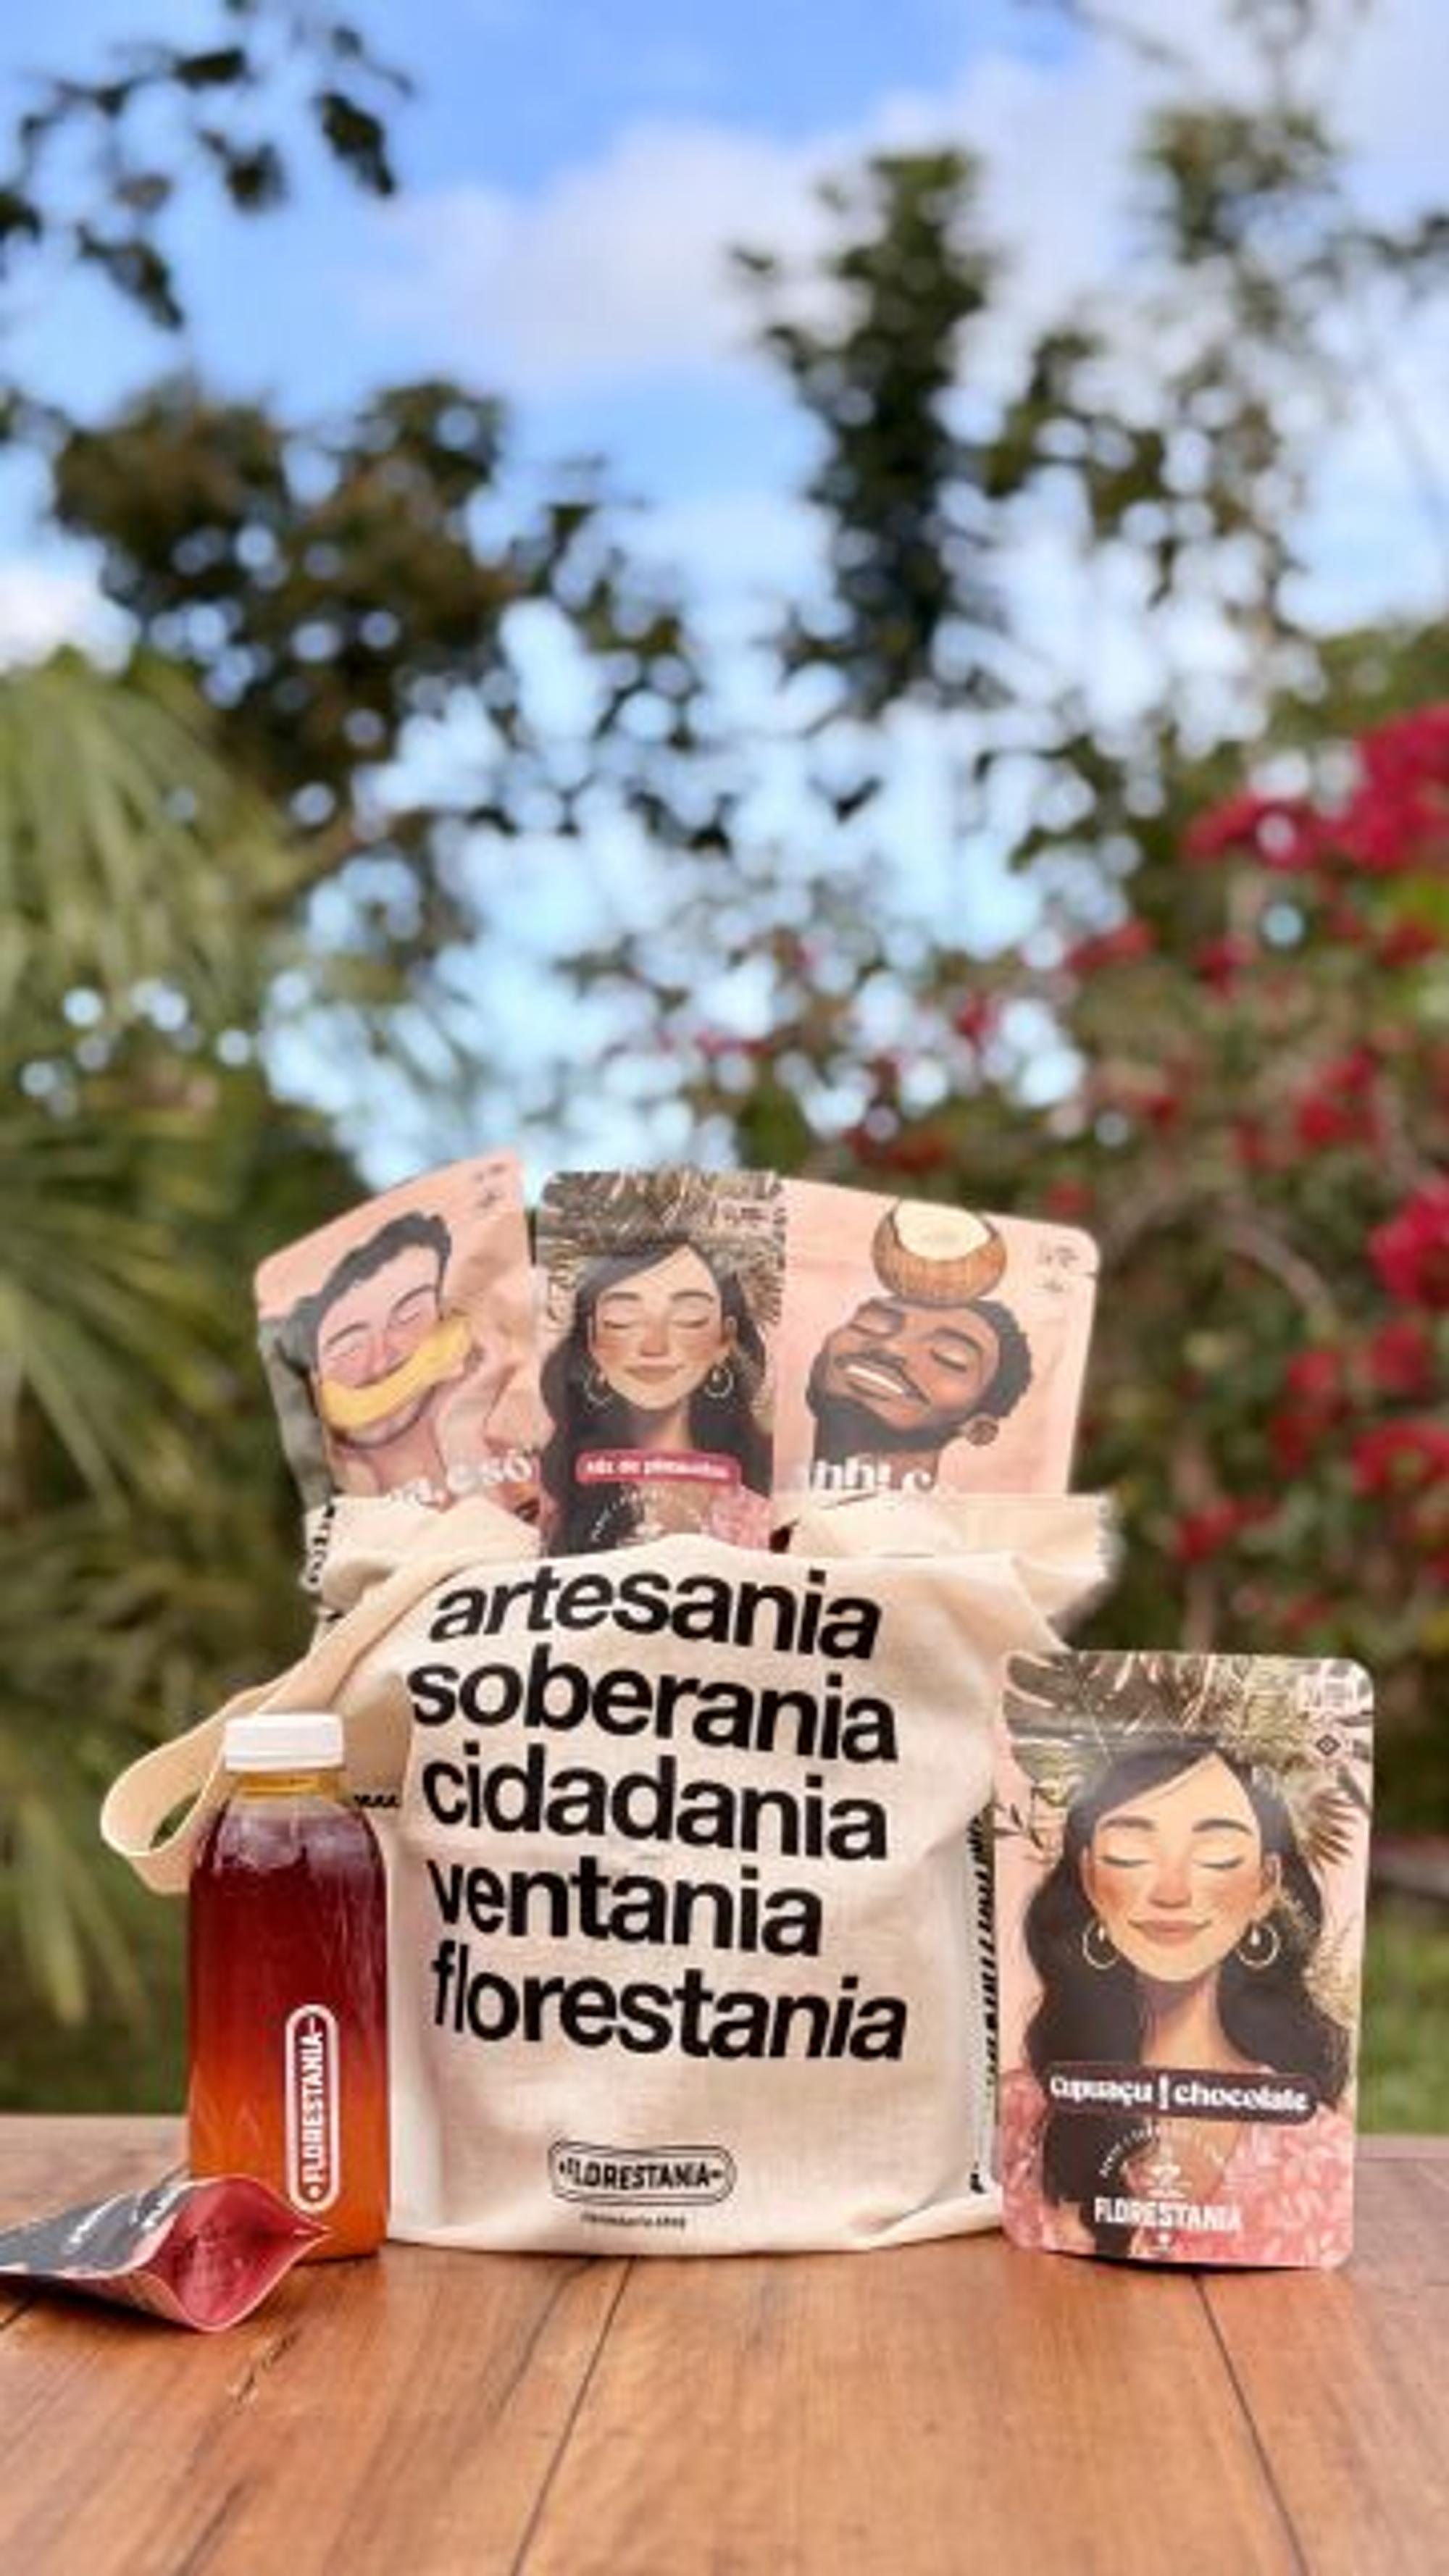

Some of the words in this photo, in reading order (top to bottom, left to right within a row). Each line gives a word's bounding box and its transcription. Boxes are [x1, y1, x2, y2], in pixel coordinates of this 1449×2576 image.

[430, 1567, 882, 1660] artesania
[407, 1644, 898, 1763] soberania
[422, 1741, 887, 1860] cidadania
[426, 1856, 822, 1957] ventania
[430, 1939, 907, 2060] florestania
[298, 2031, 325, 2184] FLORESTANIA
[1174, 2081, 1309, 2112] chocolate
[567, 2157, 710, 2190] FLORESTANIA
[1093, 2196, 1243, 2231] FLORESTANIA
